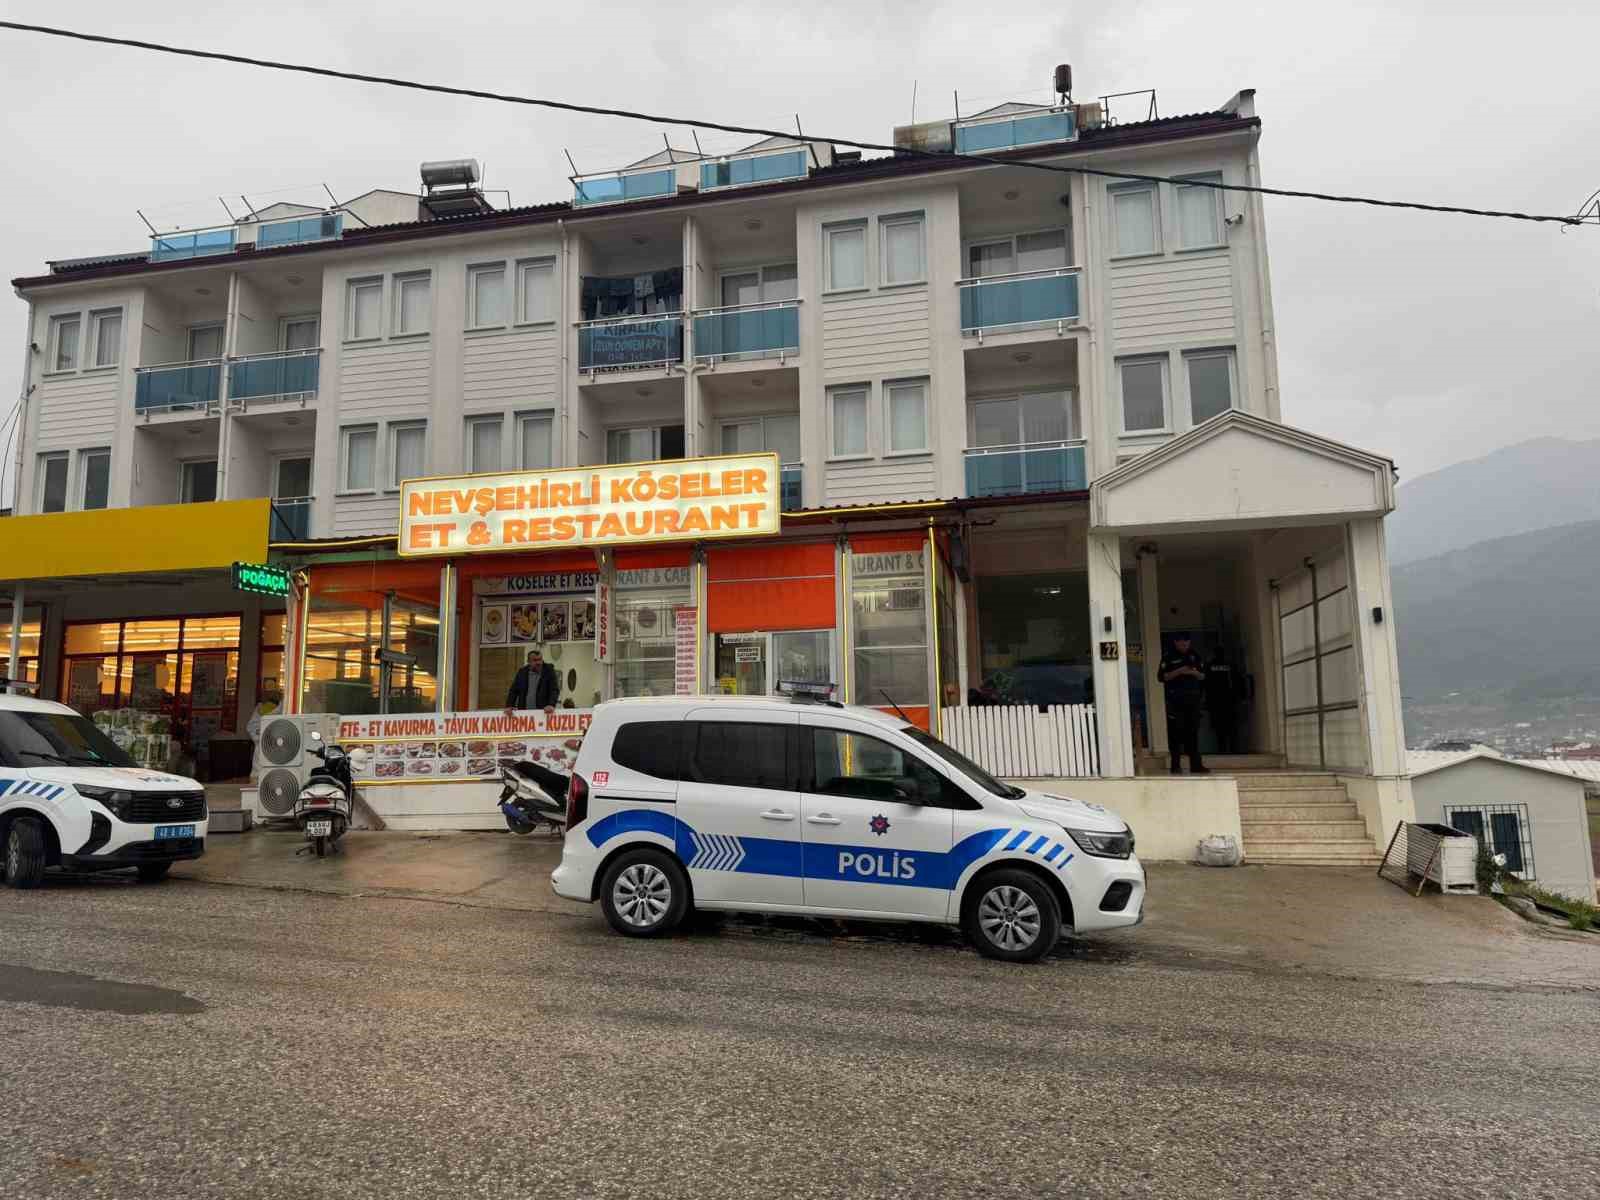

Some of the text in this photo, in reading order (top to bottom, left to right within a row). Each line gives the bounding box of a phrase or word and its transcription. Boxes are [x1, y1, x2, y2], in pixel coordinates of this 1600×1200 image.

[409, 468, 768, 517] NEVŞEHİRLİ KÖSELER
[410, 502, 768, 548] ET & RESTAURANT
[242, 568, 286, 591] POĞAÇA
[560, 573, 571, 589] ET
[600, 586, 609, 658] KASAP
[369, 720, 382, 736] ET
[384, 718, 436, 737] KAVURMA
[444, 716, 480, 735] TAVUK
[482, 715, 536, 734] KAVURMA
[546, 714, 576, 732] KUZU
[838, 851, 917, 880] POLİS
